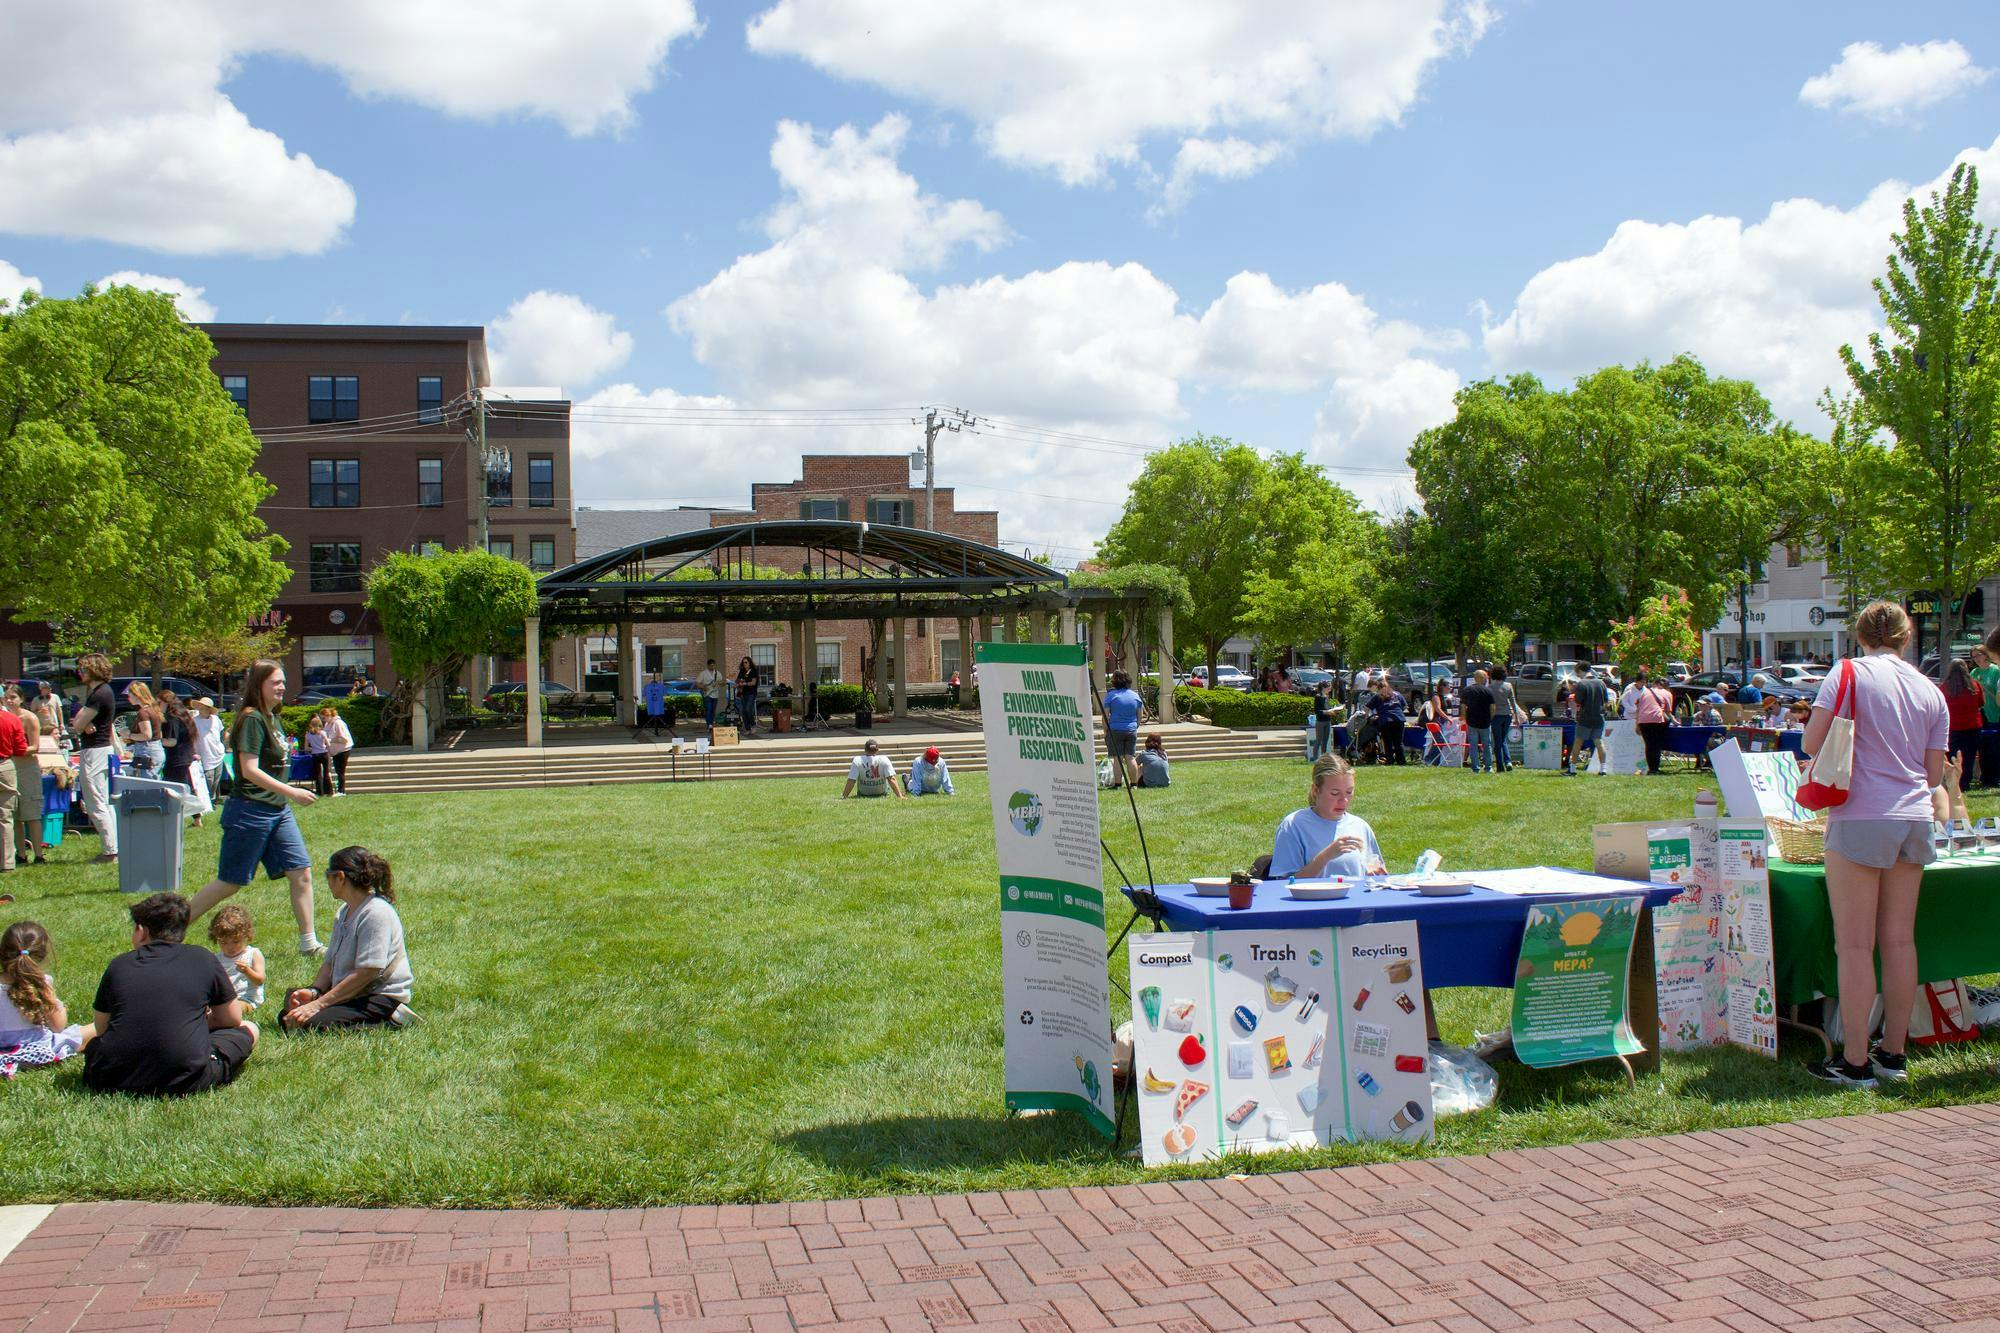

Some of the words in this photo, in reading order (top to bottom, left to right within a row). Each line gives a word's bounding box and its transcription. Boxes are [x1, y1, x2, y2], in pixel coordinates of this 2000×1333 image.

[1911, 600, 1962, 614] SUBWY
[1021, 670, 1056, 691] MIAMI
[1003, 692, 1083, 718] ENVIRONMENTAL
[1008, 715, 1086, 741] PROFESSIONALS
[1019, 739, 1084, 764] ASSOCIATION
[1051, 785, 1080, 794] Professionals
[1056, 802, 1073, 810] fostering
[1008, 806, 1044, 820] MEPA
[1075, 820, 1083, 828] help
[1052, 834, 1074, 842] confidence
[1059, 827, 1084, 836] professionals
[1659, 854, 1687, 864] PLEDGE
[1035, 928, 1060, 937] Community
[1036, 935, 1058, 943] Collaborate
[1250, 944, 1296, 961] Trash
[1352, 944, 1408, 959] Recycling
[1139, 953, 1192, 966] Compost
[1554, 957, 1595, 973] MEPA?
[1026, 984, 1047, 992] practical
[1235, 1008, 1255, 1031] YOGURT
